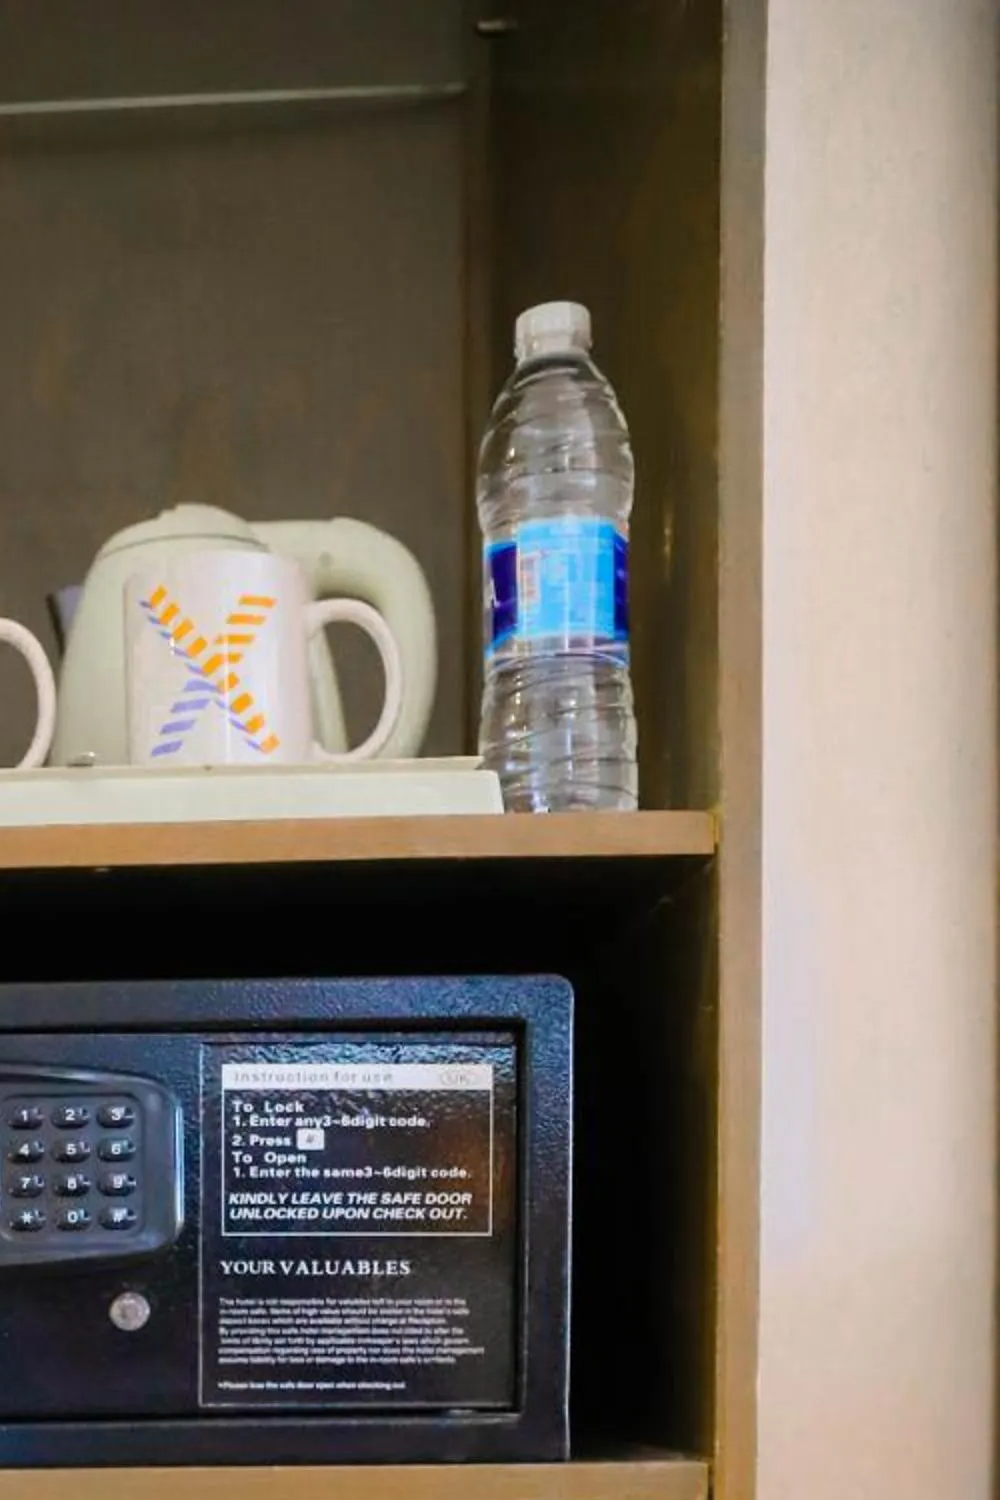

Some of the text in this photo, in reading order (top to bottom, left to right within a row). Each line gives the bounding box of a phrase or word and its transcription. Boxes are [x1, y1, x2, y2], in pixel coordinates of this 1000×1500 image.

[232, 1100, 305, 1113] To Lock
[65, 1109, 75, 1120] 2
[250, 1134, 292, 1146] Press
[20, 1144, 30, 1155] 4
[66, 1144, 76, 1155] 5
[231, 1151, 307, 1165] To Open
[249, 1165, 291, 1178] Enter
[294, 1166, 320, 1178] the
[21, 1177, 31, 1188] 7
[228, 1191, 473, 1205] KINDLY LEAVE THE SAFE DOOR
[229, 1207, 468, 1219] UNLOCKED UPON CHECK OUT.
[220, 1260, 411, 1275] YOUR VALUABLES
